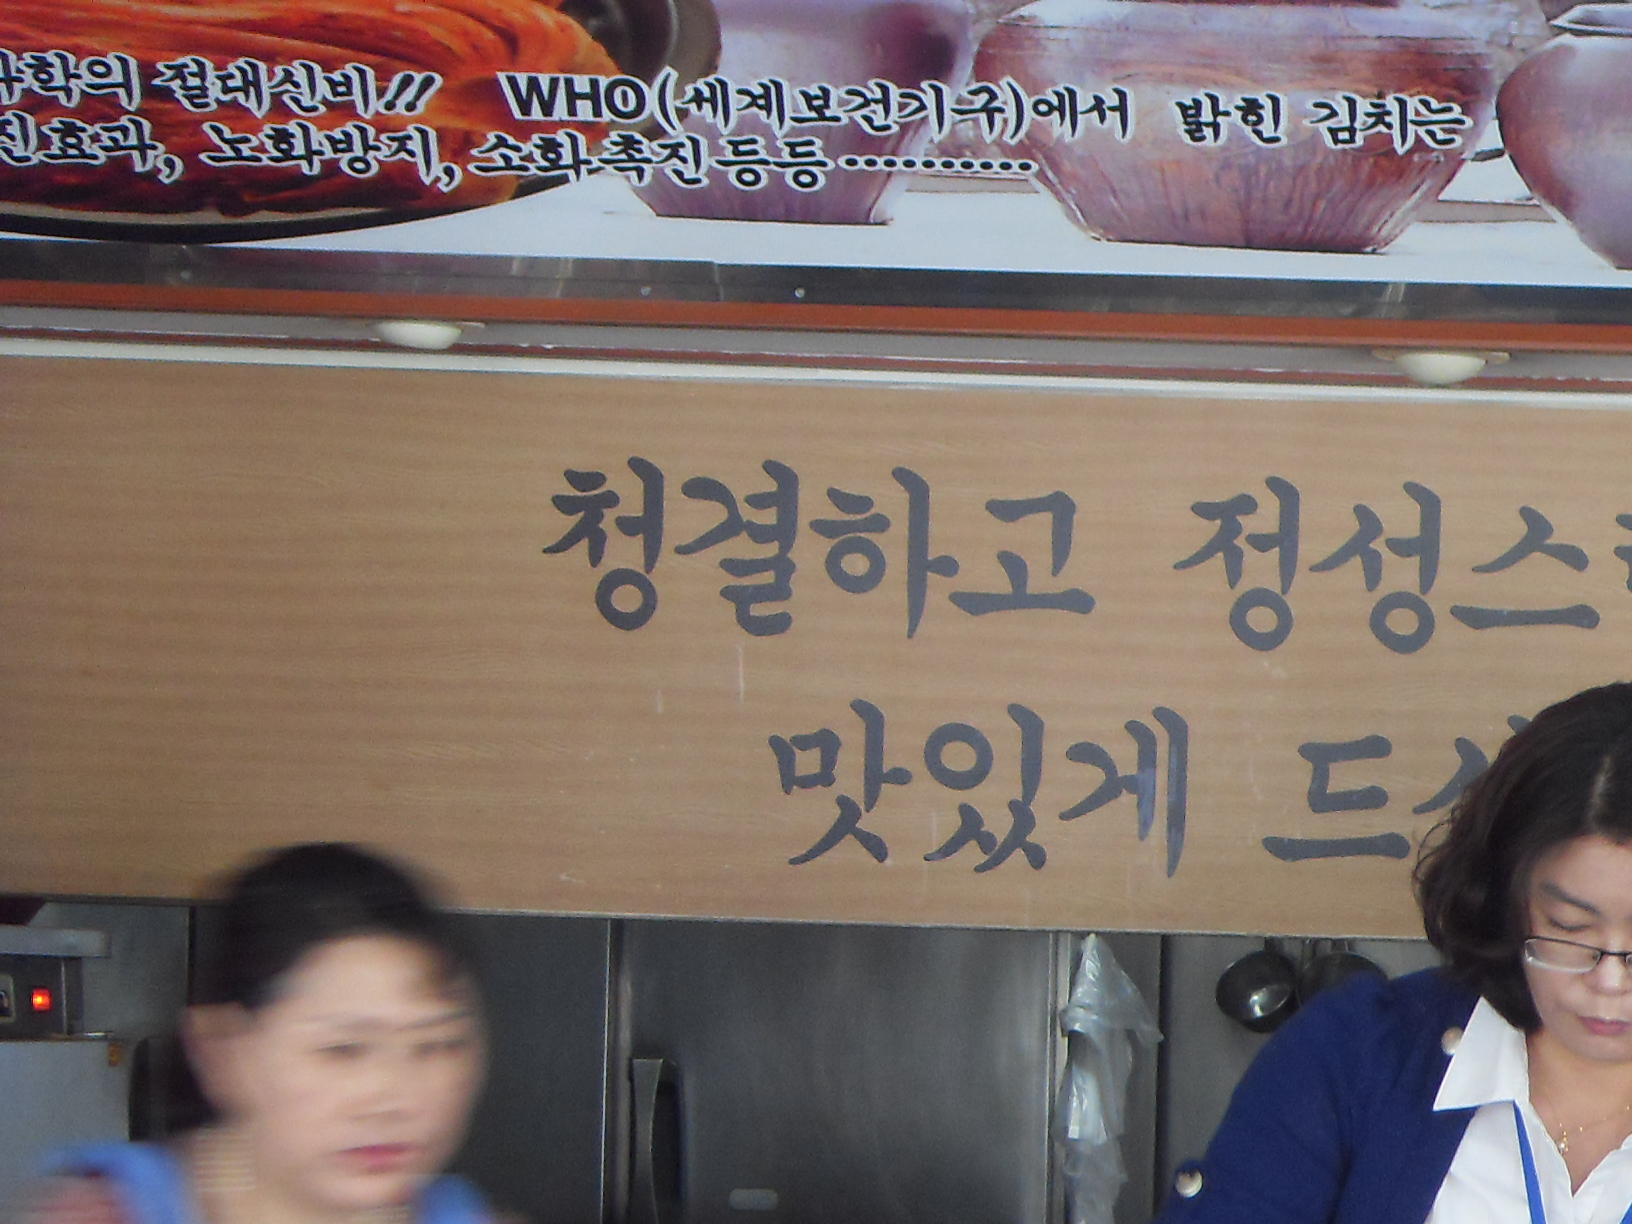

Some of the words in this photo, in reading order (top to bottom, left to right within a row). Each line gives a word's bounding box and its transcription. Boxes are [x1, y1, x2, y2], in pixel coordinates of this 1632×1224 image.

[1174, 91, 1283, 144] 밝힌
[1307, 94, 1467, 149] 김치는
[541, 454, 1096, 640] 청결하고
[768, 698, 1190, 879] 맛있게
